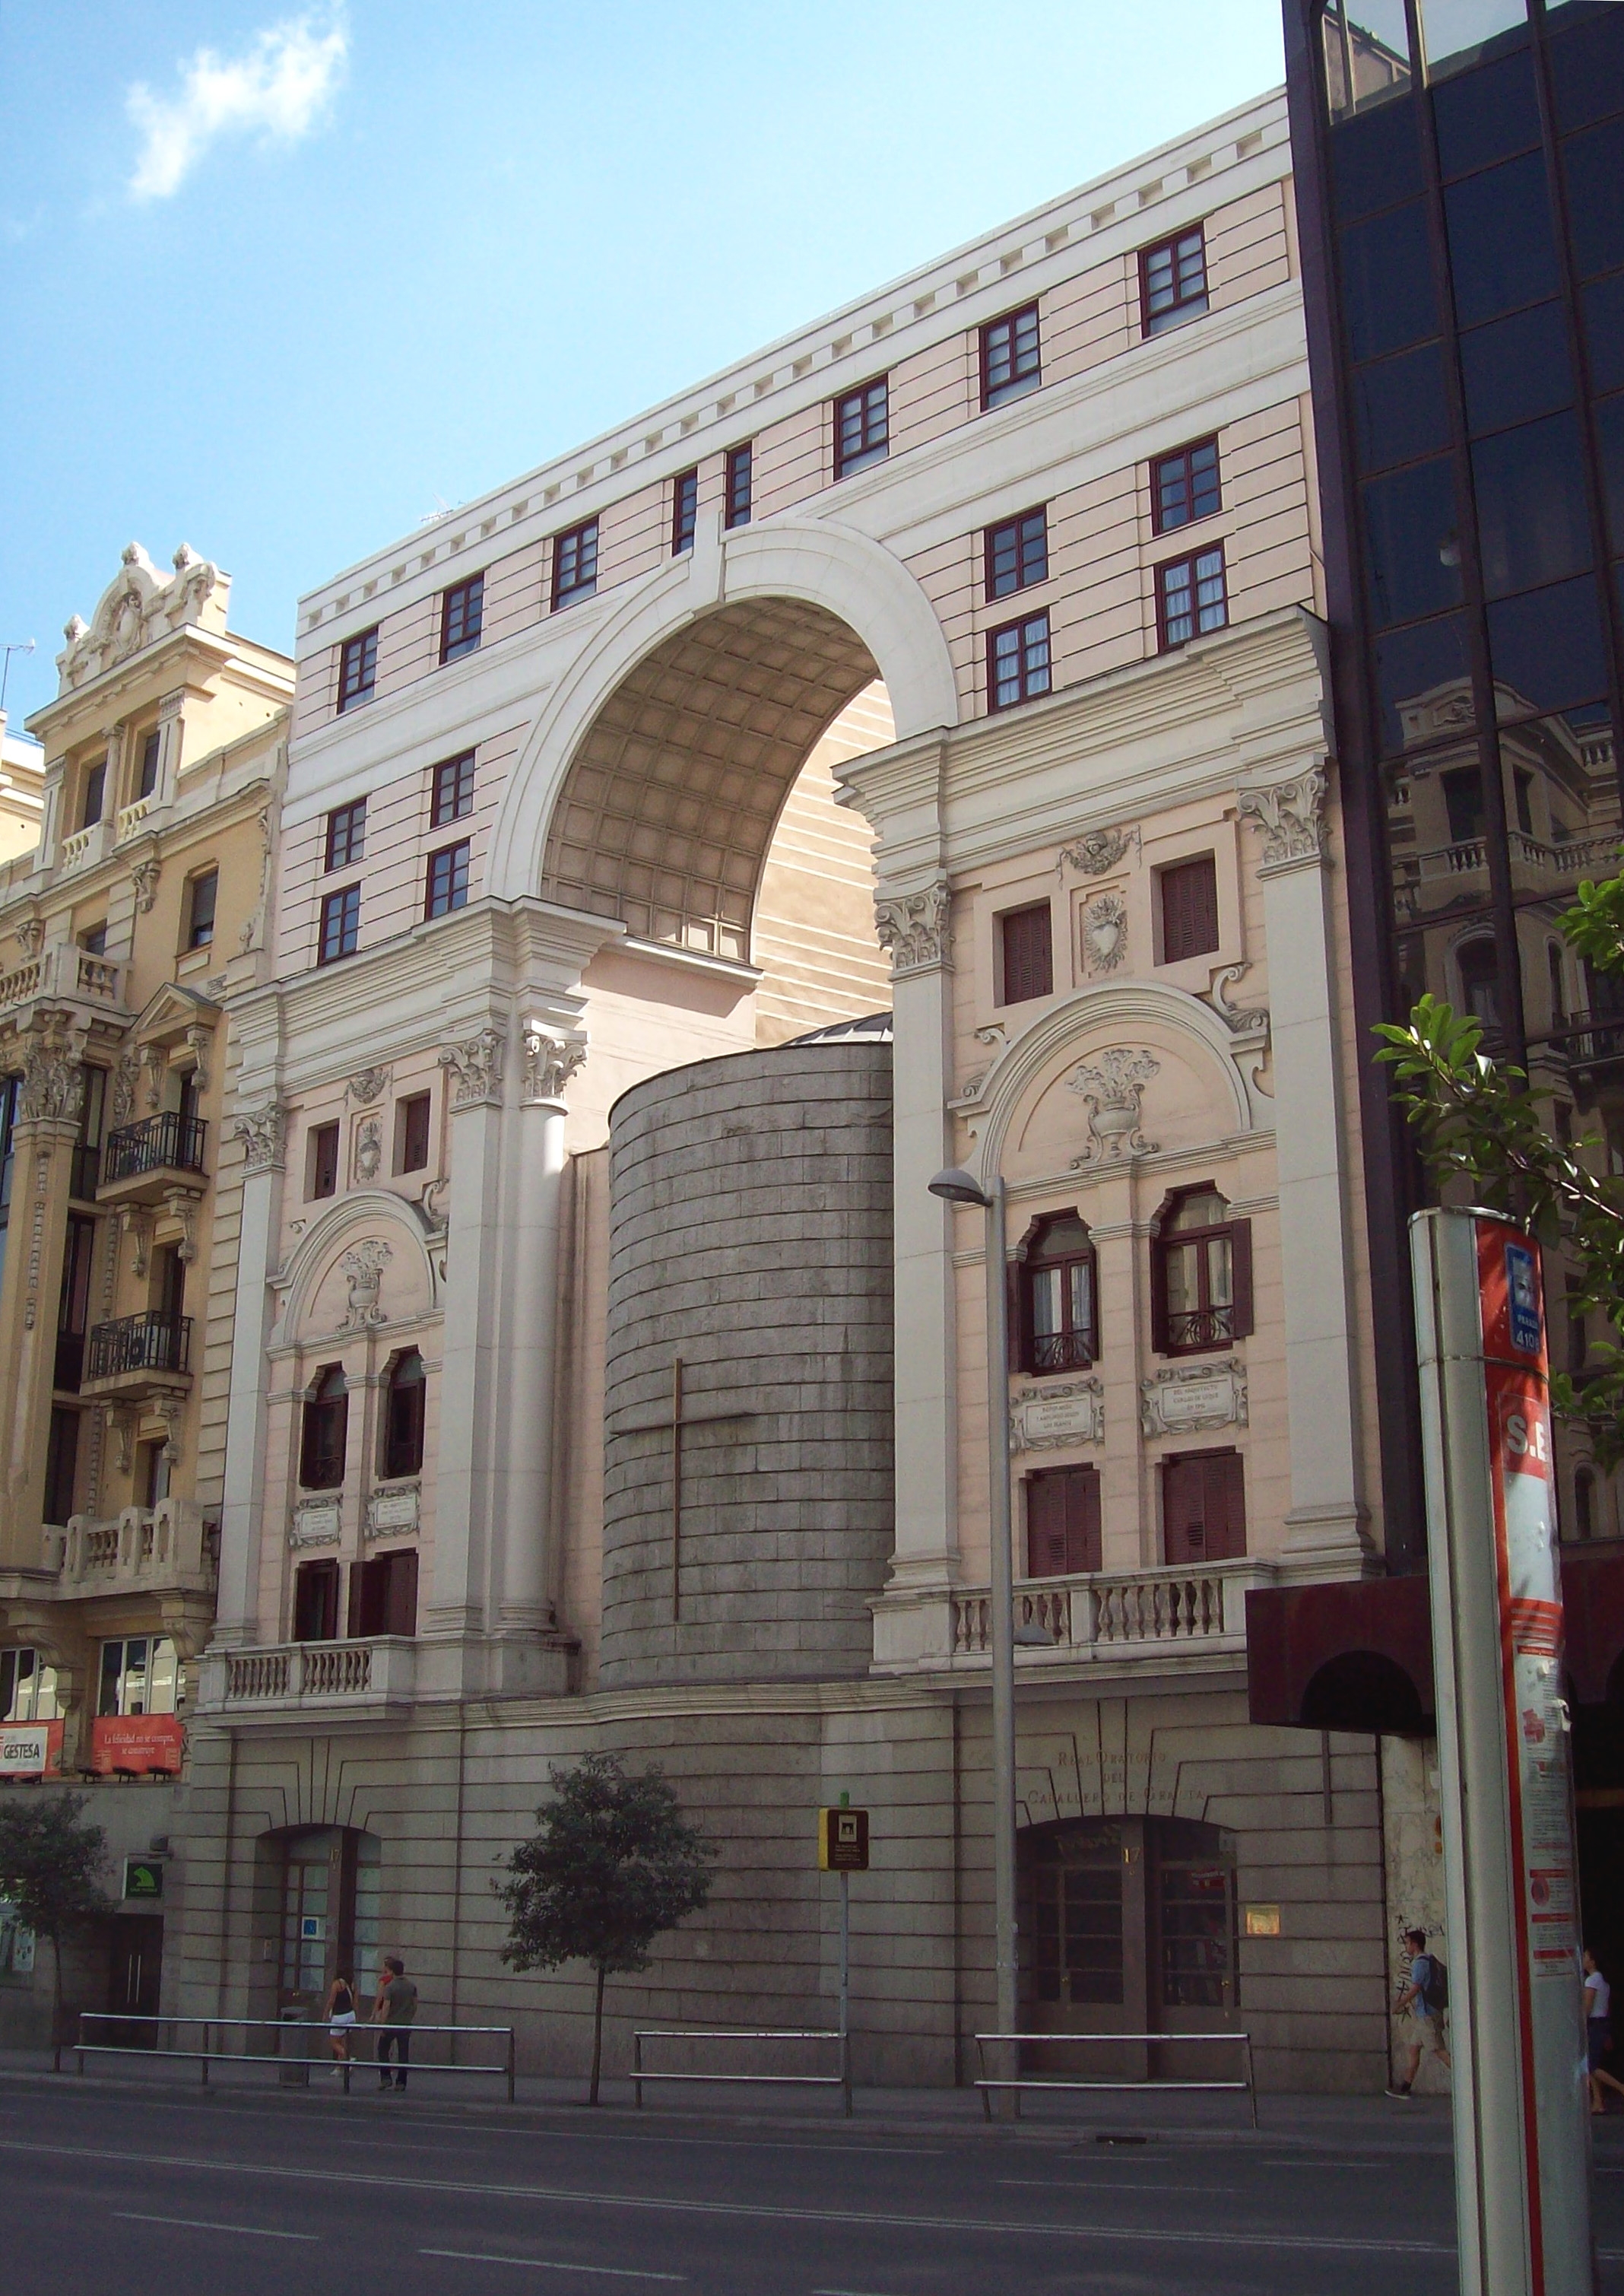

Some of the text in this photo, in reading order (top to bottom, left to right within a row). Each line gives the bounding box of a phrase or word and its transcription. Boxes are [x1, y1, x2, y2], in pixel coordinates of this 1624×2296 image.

[104, 1734, 112, 1745] La
[4, 1743, 40, 1759] GESTESA
[1123, 1847, 1140, 1863] 17
